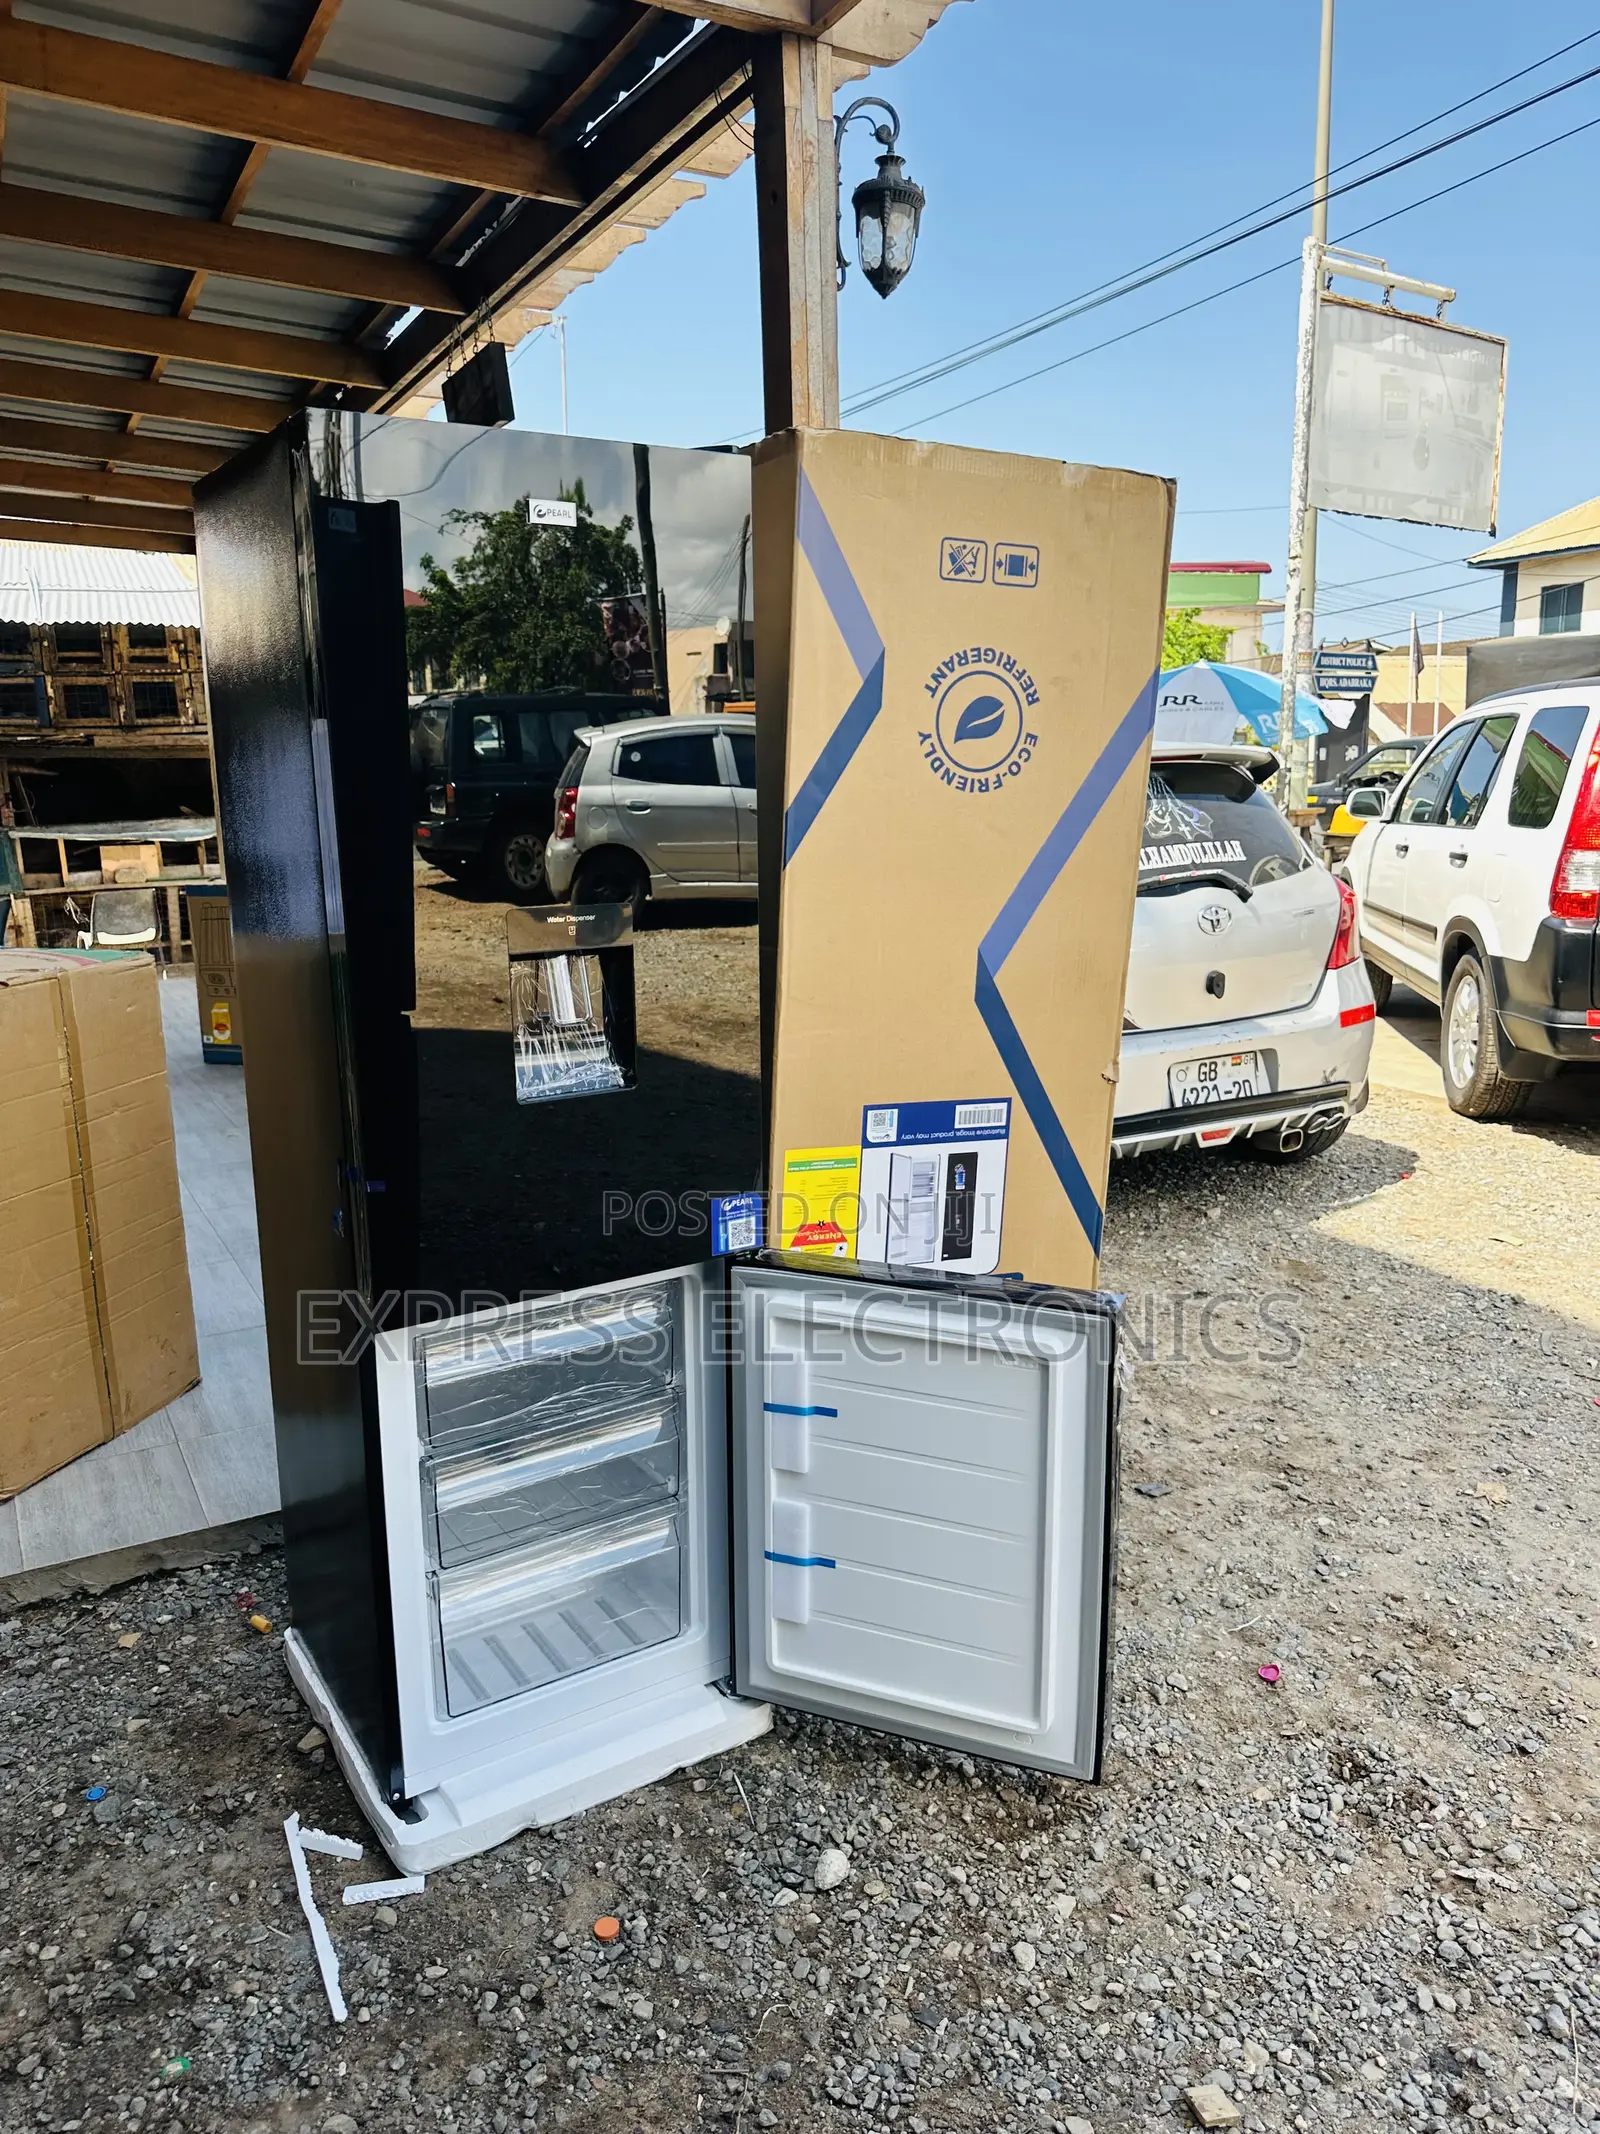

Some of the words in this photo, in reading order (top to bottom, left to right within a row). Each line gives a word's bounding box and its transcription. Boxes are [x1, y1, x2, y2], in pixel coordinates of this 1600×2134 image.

[546, 508, 572, 519] PEARL
[1320, 656, 1346, 666] DISTRICT
[1346, 657, 1367, 667] POLICE
[924, 647, 1040, 707] REFRIGERANT
[917, 730, 1040, 793] ECO-FRIENDLY
[1139, 840, 1247, 870] LHAMDULILLAH
[546, 916, 565, 924] Water
[566, 914, 596, 923] Dispenser
[1198, 1061, 1218, 1082] GB
[1180, 1079, 1254, 1106] 4221-20
[930, 1131, 954, 1139] product
[731, 1197, 754, 1207] PEARL
[807, 1231, 842, 1242] ENERGY
